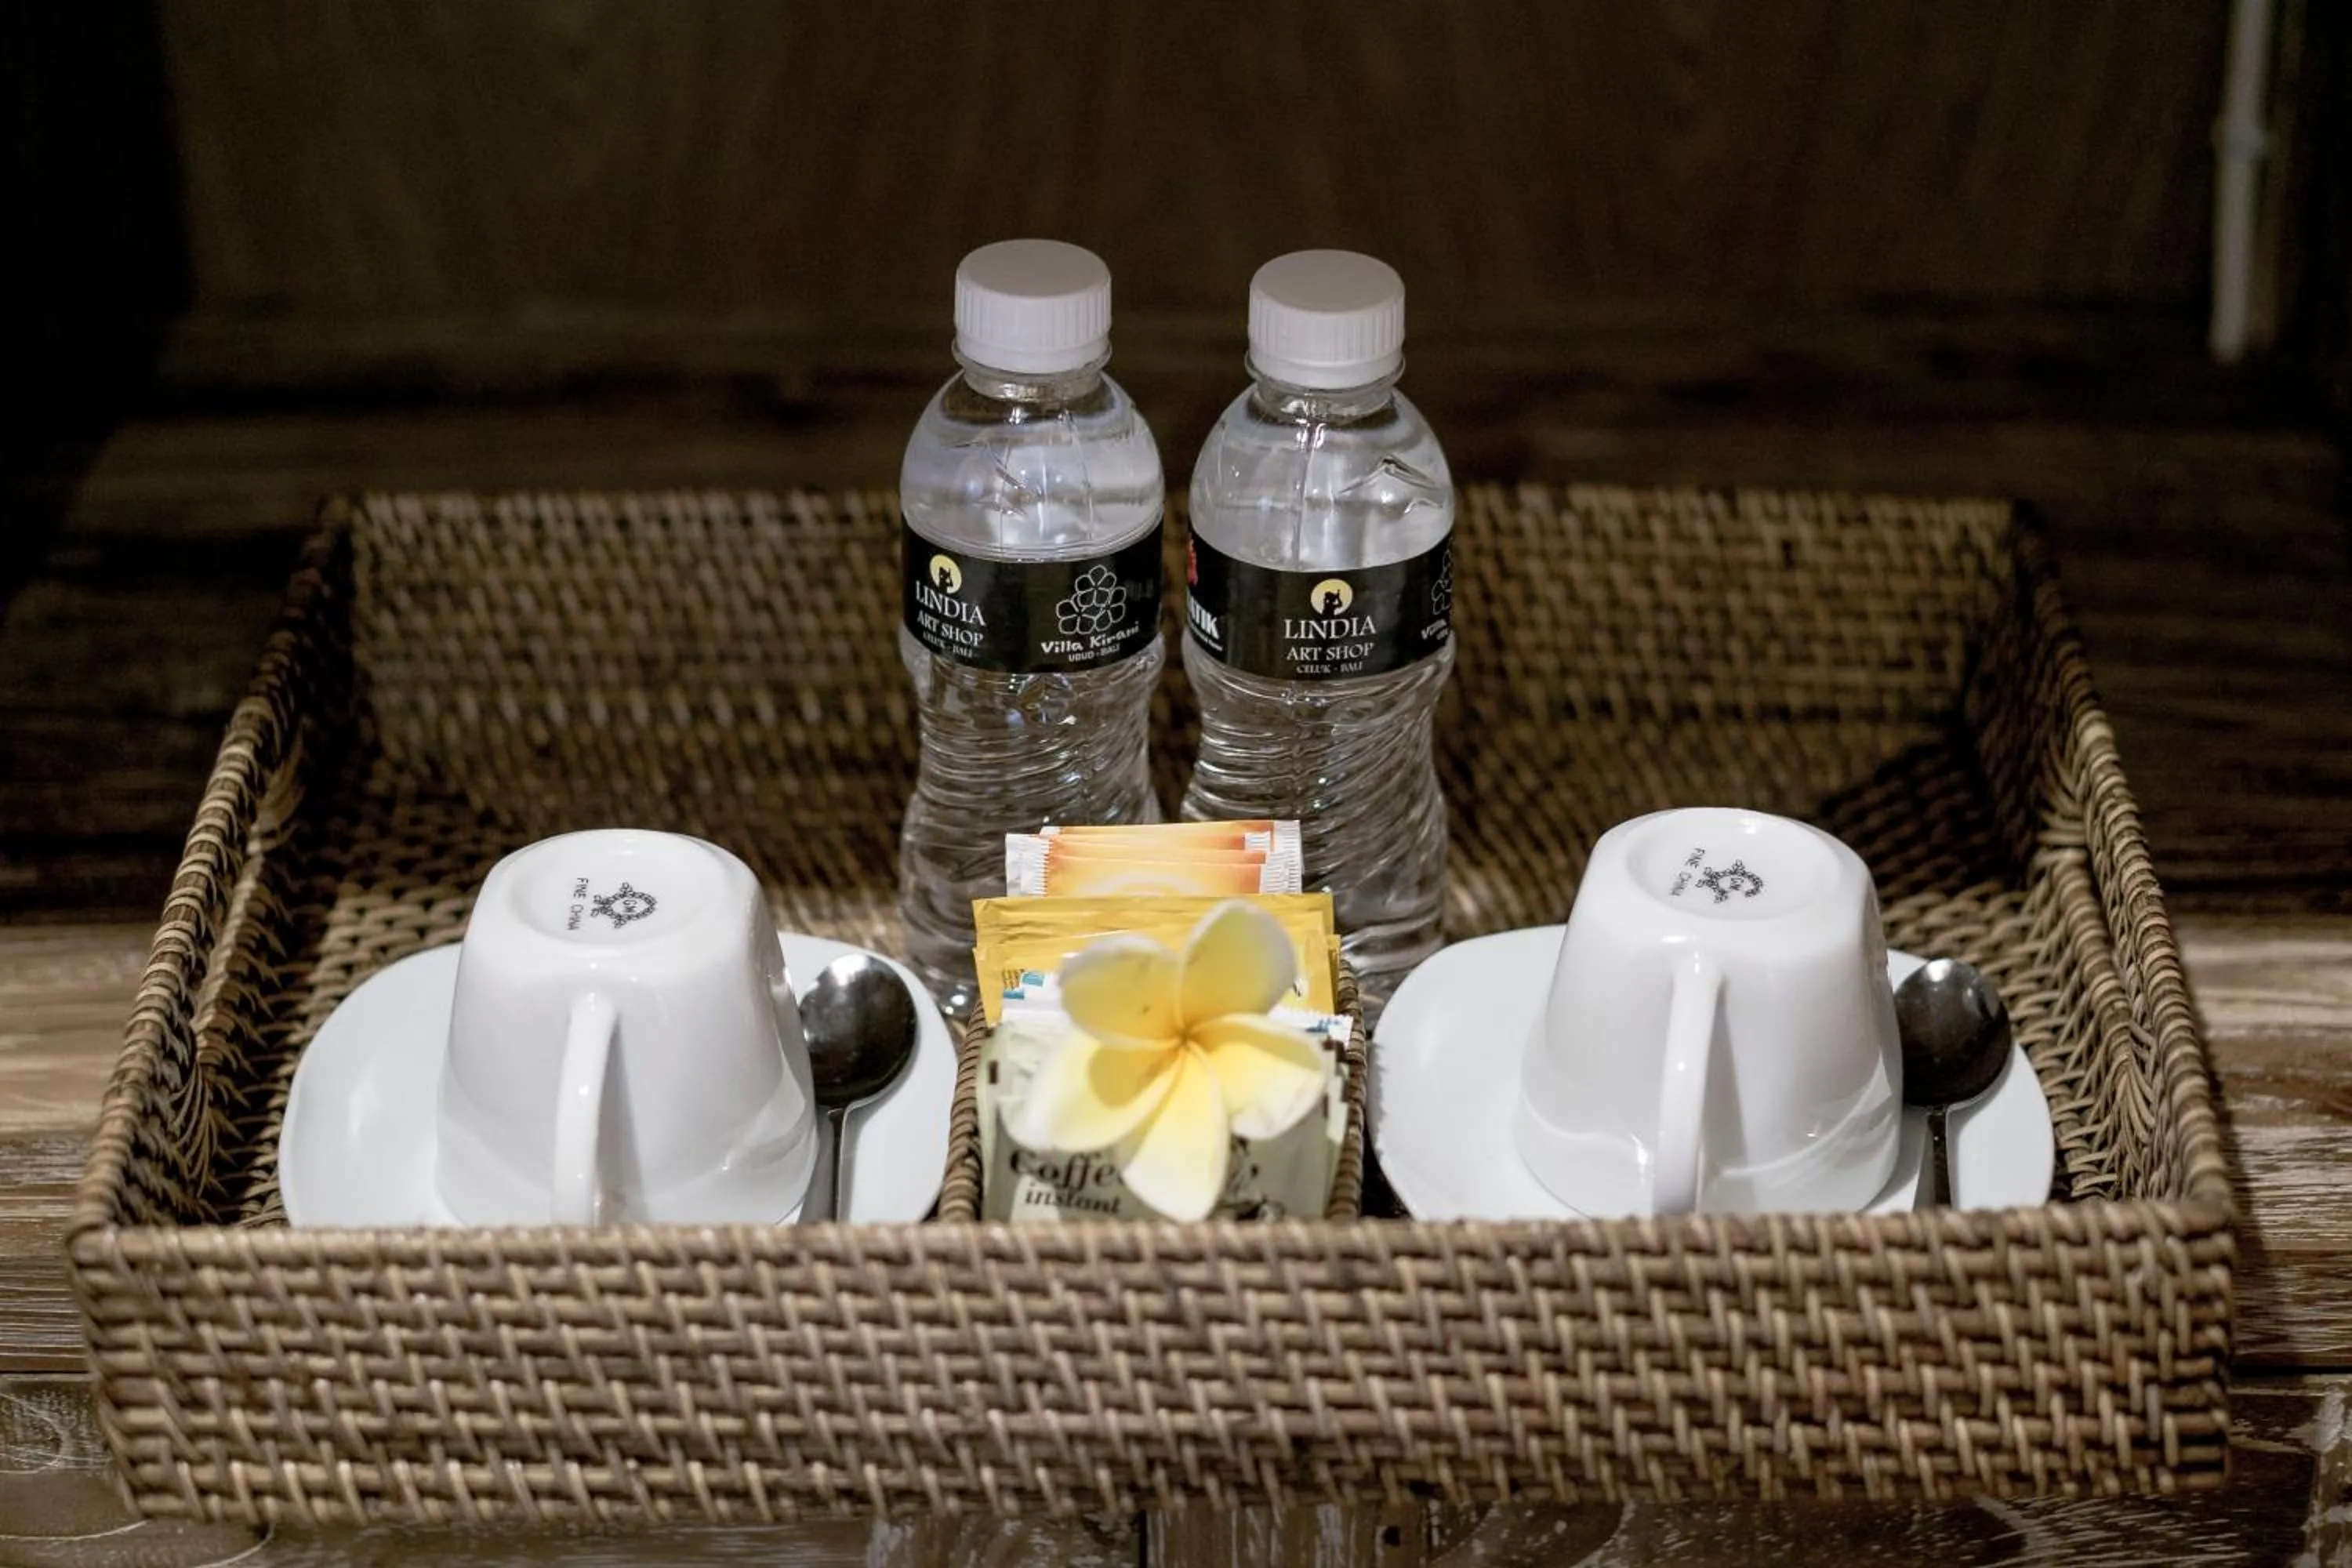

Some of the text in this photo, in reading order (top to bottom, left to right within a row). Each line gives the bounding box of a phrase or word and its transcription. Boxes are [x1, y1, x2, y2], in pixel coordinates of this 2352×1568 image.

[916, 580, 986, 626] LINDIA
[917, 609, 984, 648] ART SHOP
[1040, 621, 1139, 654] Villa Kirani
[1283, 615, 1377, 640] LINDIA
[1286, 643, 1374, 661] ART SHOP
[573, 877, 589, 900] FINE
[1008, 1149, 1125, 1192] Coffe
[1024, 1181, 1122, 1214] instant
